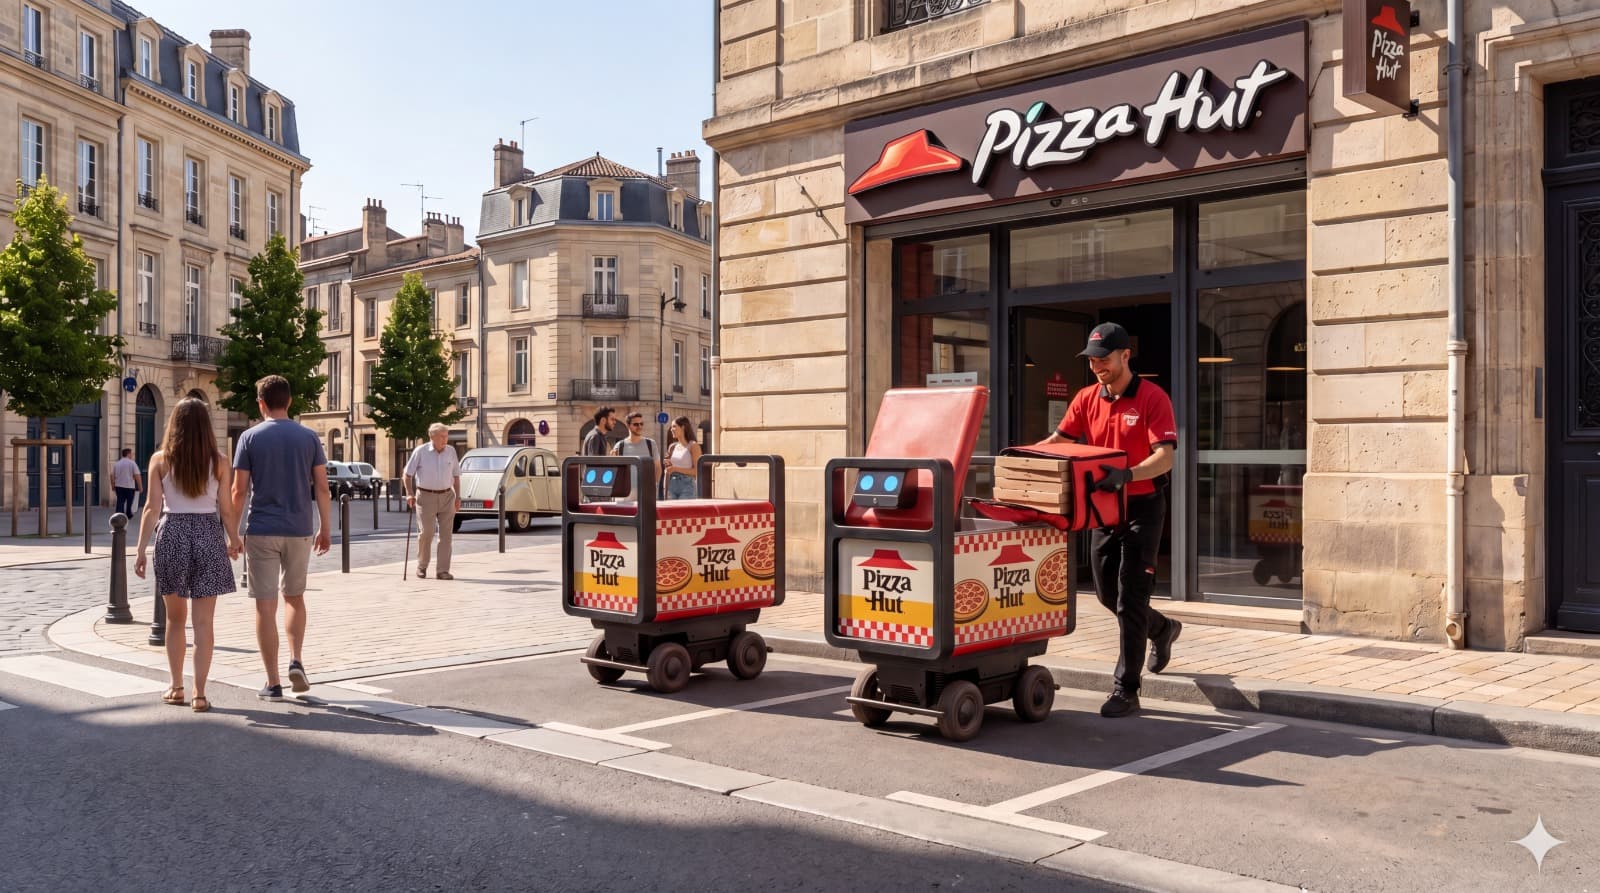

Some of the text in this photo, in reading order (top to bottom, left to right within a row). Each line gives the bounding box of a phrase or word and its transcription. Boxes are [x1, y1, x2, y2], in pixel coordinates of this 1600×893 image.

[1371, 29, 1404, 59] Pizza
[1376, 56, 1402, 80] Hut
[972, 60, 1289, 184] Pizza Hut
[590, 549, 625, 569] Pizza
[696, 546, 735, 565] Pizza
[592, 567, 619, 586] Hut
[699, 564, 730, 582] Hut
[863, 569, 912, 592] Pizza
[993, 566, 1030, 587] Pizza
[865, 591, 903, 613] Hut
[995, 587, 1024, 609] Hut
